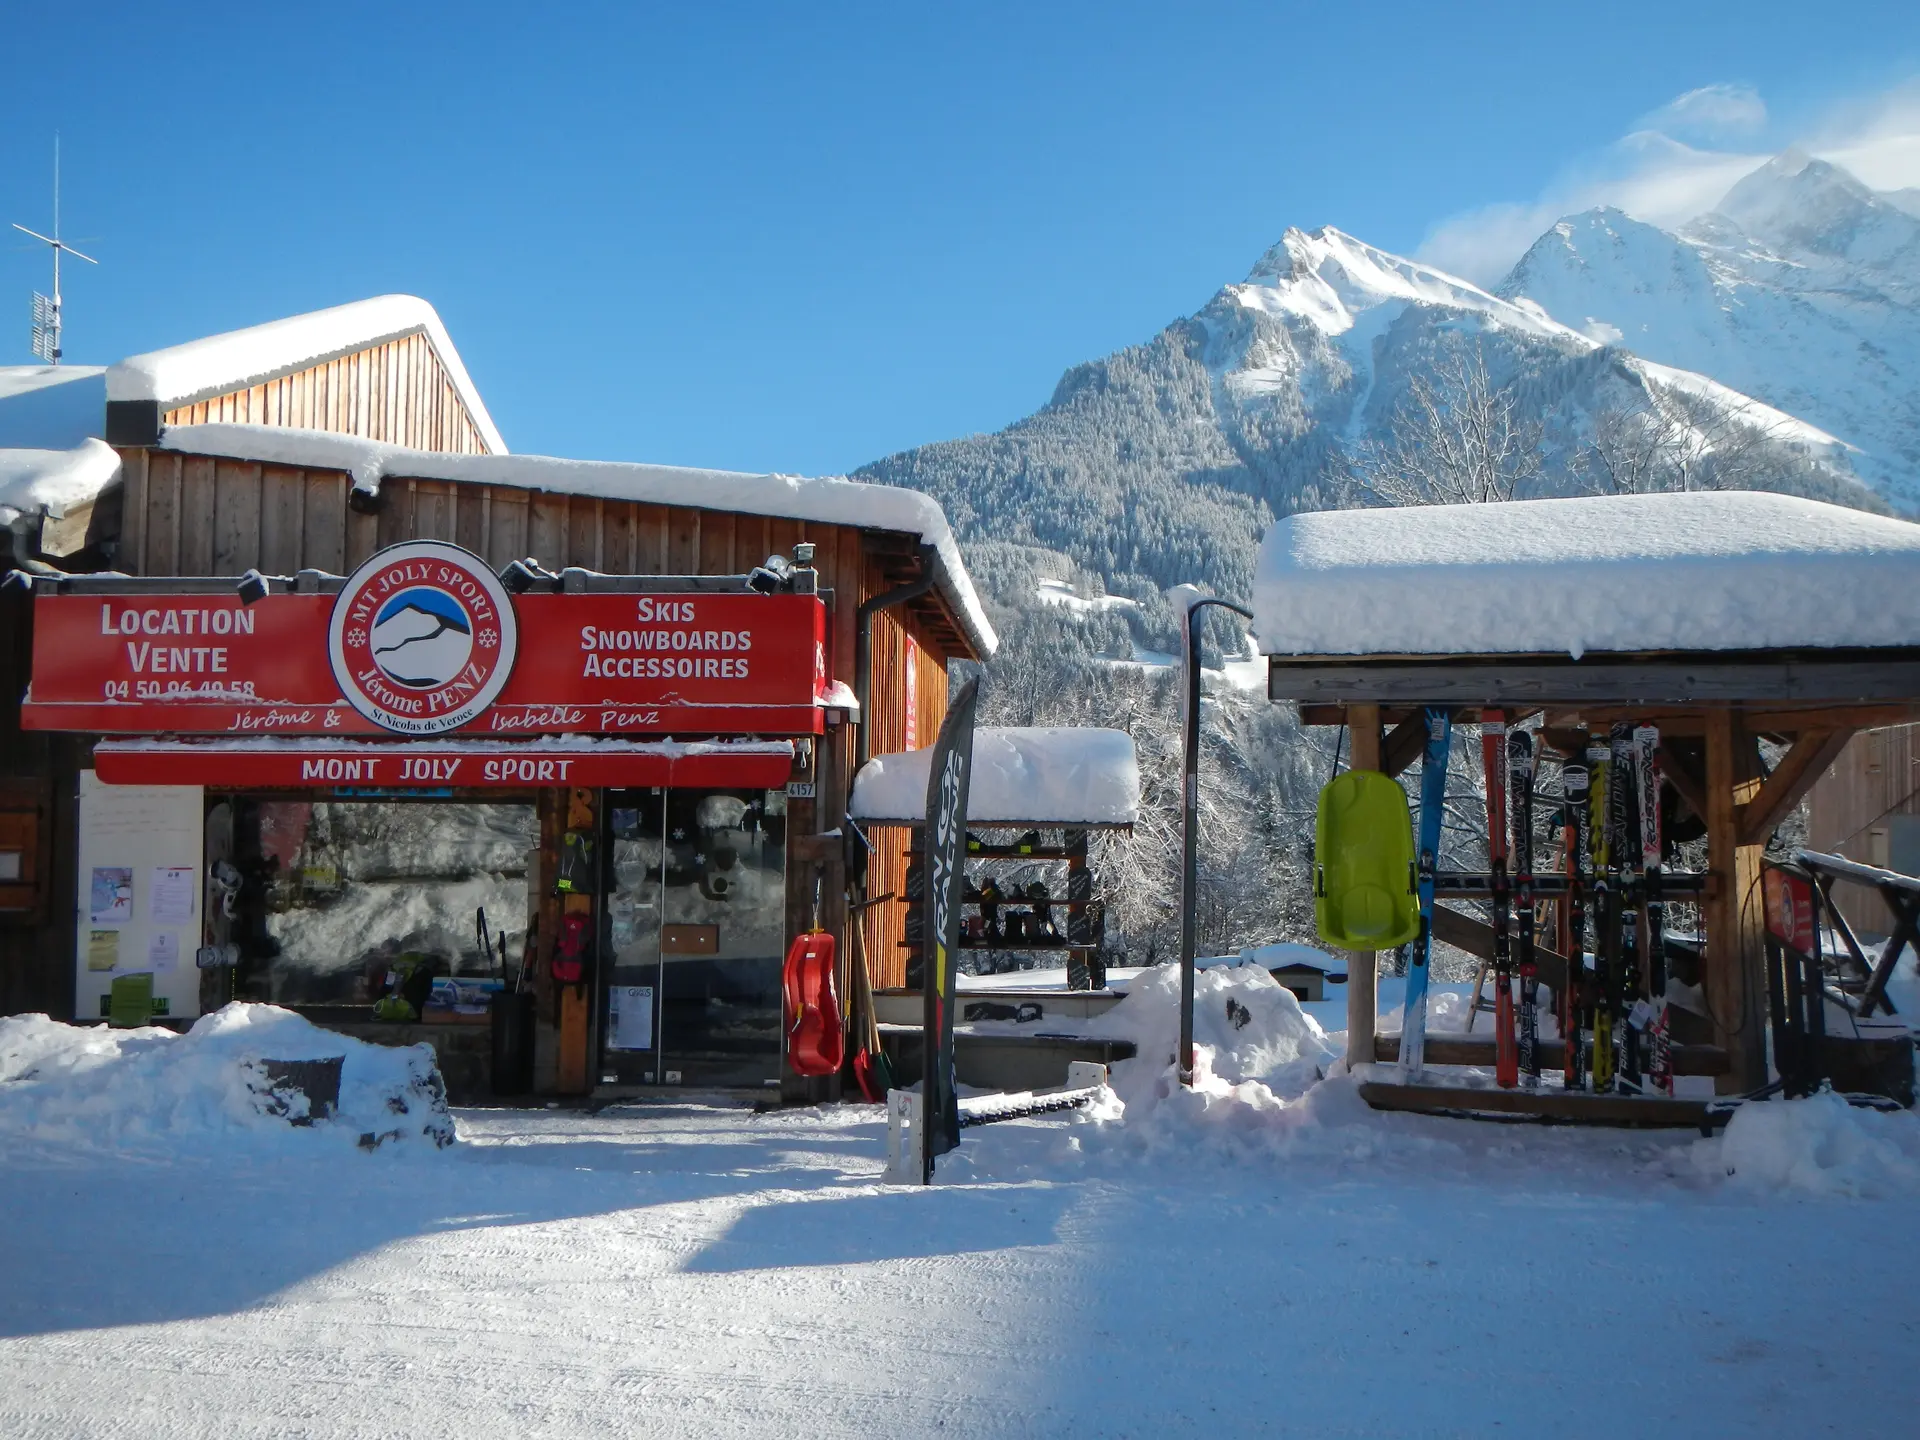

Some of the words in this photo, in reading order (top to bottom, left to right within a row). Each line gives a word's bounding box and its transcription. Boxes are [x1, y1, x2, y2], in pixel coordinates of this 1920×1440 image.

[351, 588, 378, 623] MT
[378, 563, 433, 593] JOLY
[437, 567, 493, 623] SPORT
[101, 603, 255, 635] LOCATION
[637, 597, 696, 622] SKIS
[580, 625, 752, 651] SNOWBOARDS
[127, 641, 228, 673] VENTE
[583, 653, 749, 678] ACCESSOIRES
[104, 680, 129, 698] 04
[135, 680, 161, 698] 50
[167, 680, 193, 697] 96
[230, 681, 256, 699] 58
[358, 668, 423, 713] Jérome
[426, 661, 488, 712] PENZ
[227, 709, 316, 731] Jérôme
[323, 708, 341, 728] &
[491, 705, 587, 731] Isabelle
[600, 710, 660, 731] Penz
[371, 708, 383, 721] St
[384, 714, 422, 732] Nicolas
[424, 721, 437, 731] de
[438, 708, 474, 726] Veroce
[302, 758, 382, 780] MONT
[400, 758, 462, 780] JOLY
[484, 758, 575, 781] SPORT
[1496, 738, 1505, 786] ATOMIC
[789, 783, 813, 796] 4157
[1642, 739, 1657, 848] ROSSIGNOL
